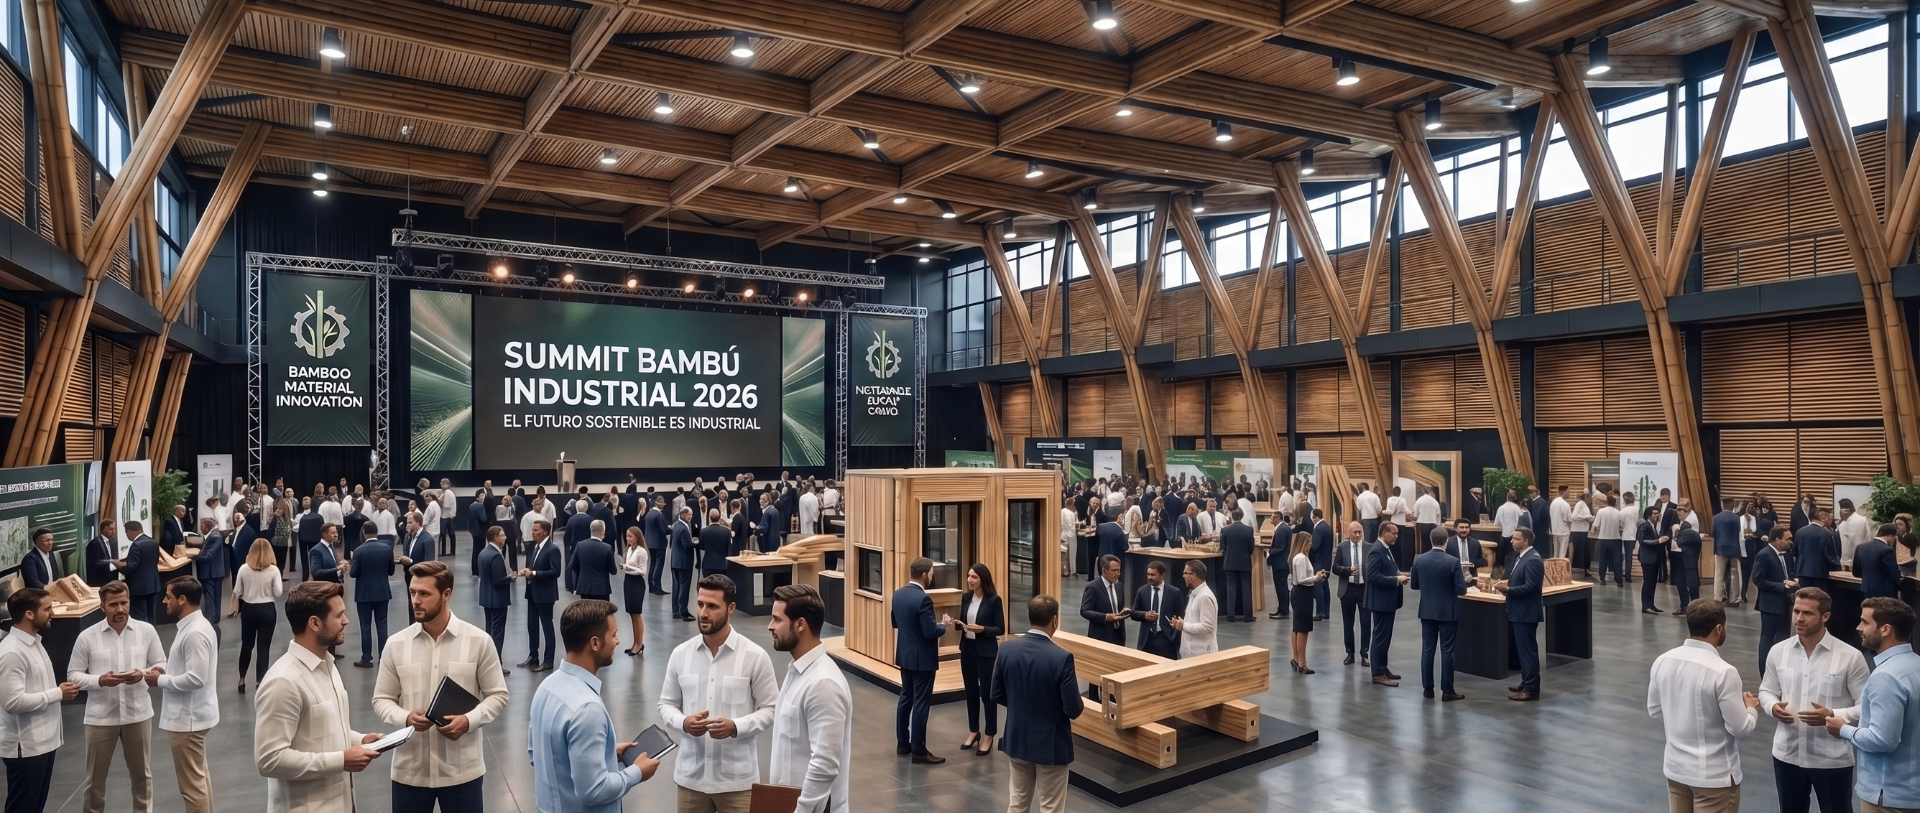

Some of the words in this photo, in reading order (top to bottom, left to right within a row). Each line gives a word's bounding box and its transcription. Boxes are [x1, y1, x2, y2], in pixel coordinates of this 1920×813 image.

[504, 341, 629, 372] SUMMIT
[638, 345, 740, 376] BAMBÚ
[288, 365, 352, 380] BAMBOO
[284, 380, 354, 395] MATERIAL
[504, 377, 686, 407] INDUSTRIAL
[693, 382, 758, 409] 2026
[276, 394, 363, 408] INNOVATION
[503, 414, 522, 428] EL
[525, 414, 583, 429] FUTURO
[585, 415, 667, 430] SOSTENIBLE
[669, 416, 686, 430] ES
[688, 416, 761, 431] INDUSTRIAL
